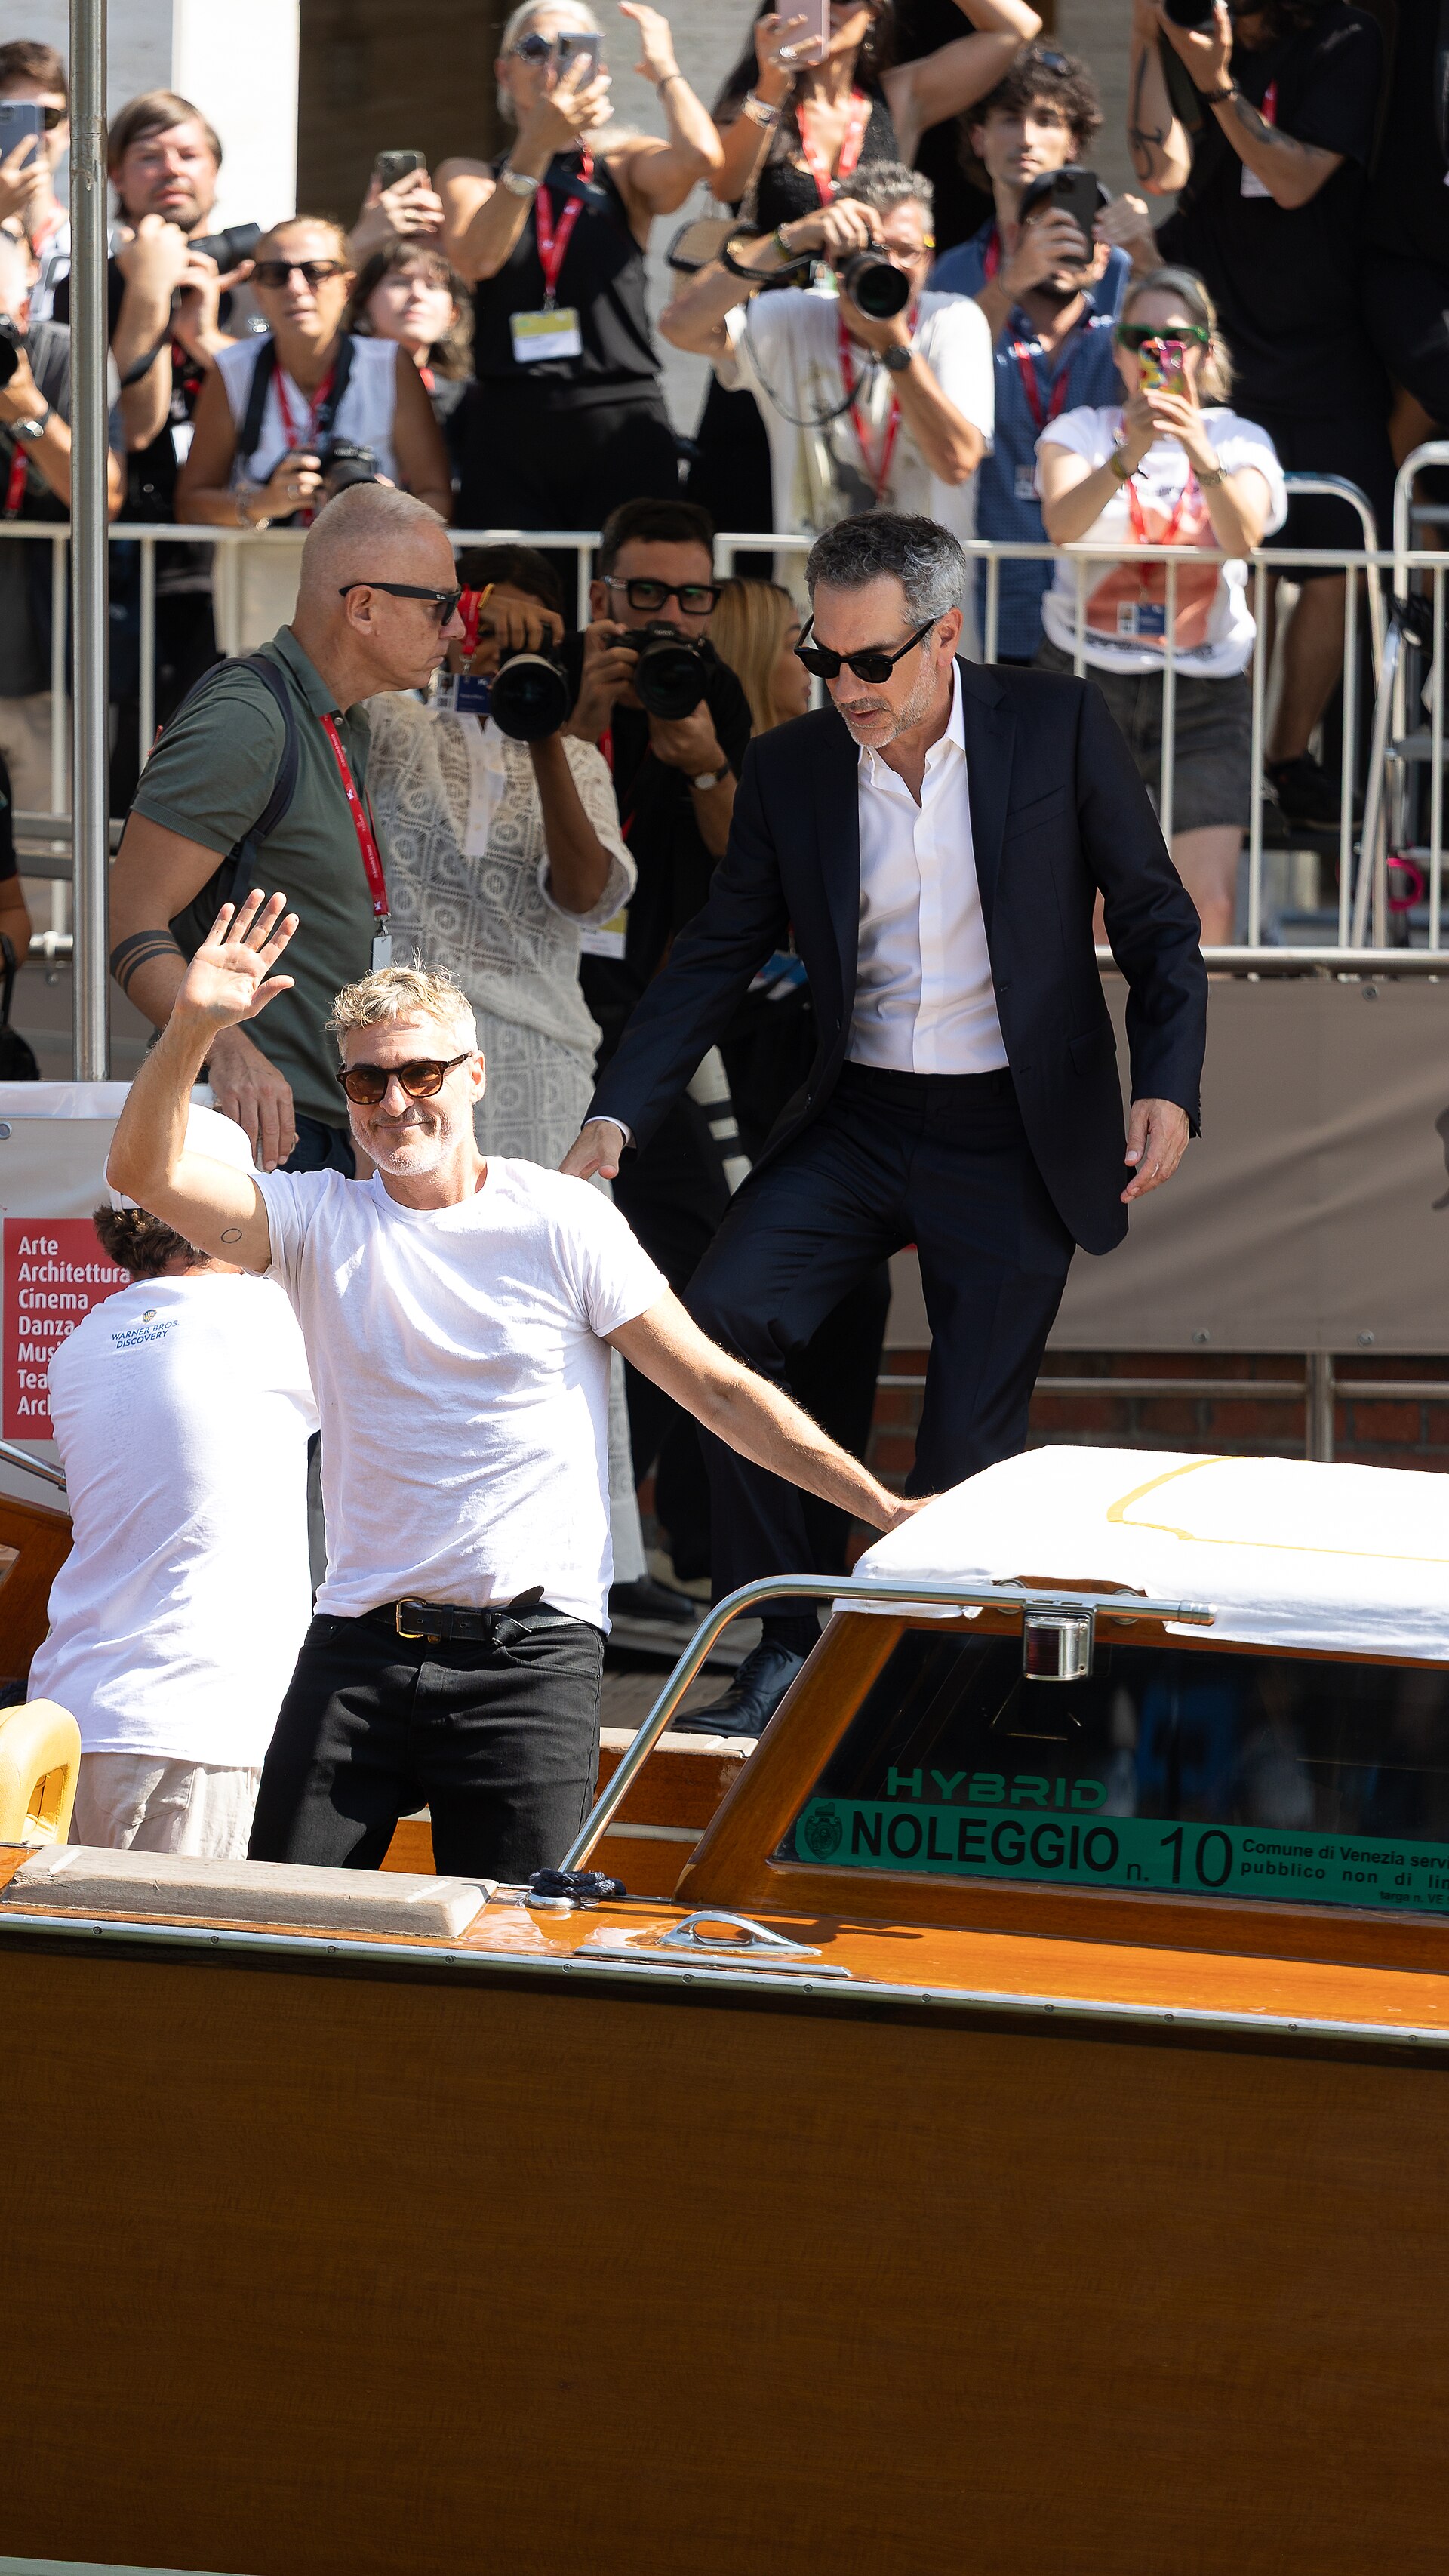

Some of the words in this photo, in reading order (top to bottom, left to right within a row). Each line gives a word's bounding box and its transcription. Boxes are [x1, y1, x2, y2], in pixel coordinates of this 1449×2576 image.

[18, 1236, 59, 1256] Arte
[18, 1260, 131, 1283] Architettura
[18, 1288, 89, 1310] Cinema
[18, 1316, 75, 1336] Danza
[112, 1326, 149, 1340] WARNER
[153, 1319, 180, 1331] BROS.
[116, 1329, 168, 1349] DISCOVERY
[17, 1341, 61, 1362] Mus
[886, 1766, 1108, 1809] HYBRID
[851, 1811, 1119, 1873] NOLEGGIO
[1127, 1863, 1149, 1882] n.
[1159, 1826, 1232, 1888] 10
[1242, 1839, 1313, 1857] Comune
[1318, 1845, 1334, 1860] di
[1340, 1846, 1404, 1866] Venezia
[1241, 1861, 1326, 1879] pubblico
[1343, 1870, 1378, 1884] non
[1394, 1873, 1412, 1886] di
[1380, 1891, 1410, 1903] targa
[1427, 1894, 1444, 1904] VE
